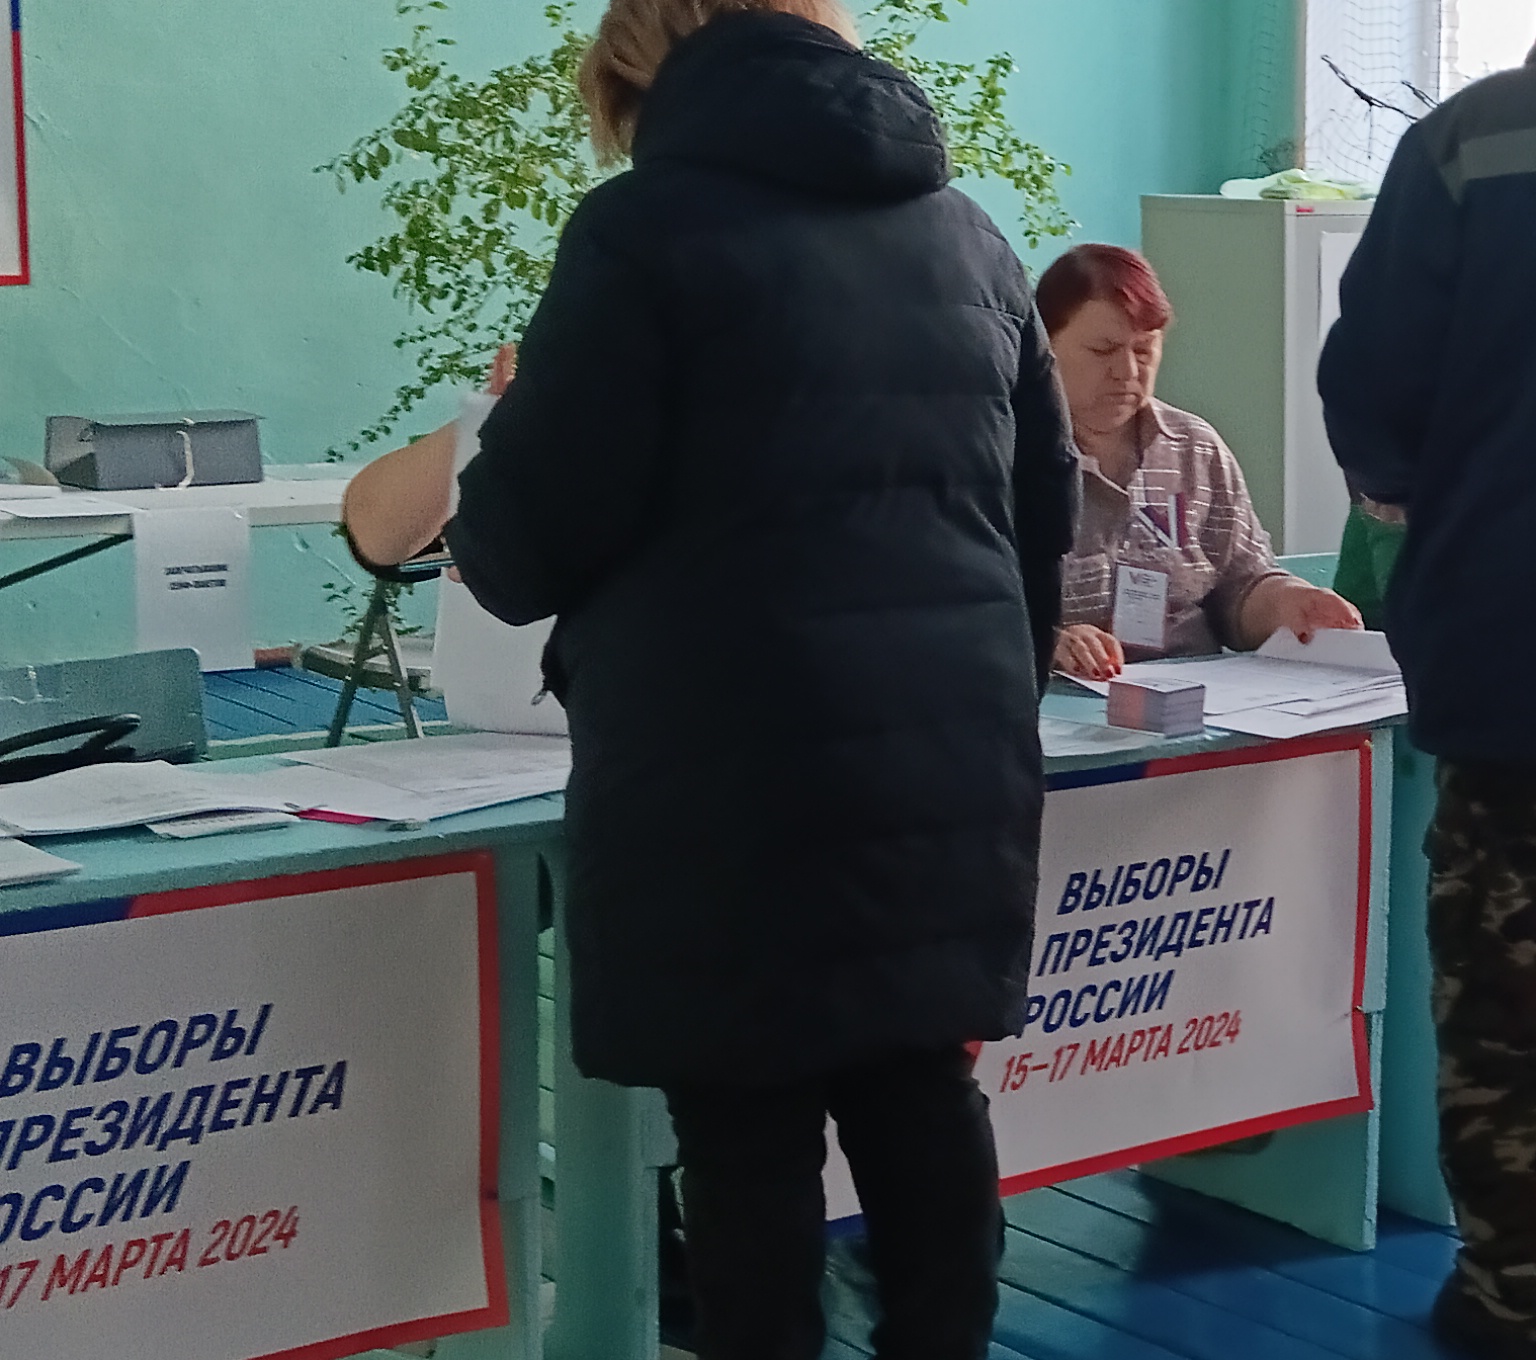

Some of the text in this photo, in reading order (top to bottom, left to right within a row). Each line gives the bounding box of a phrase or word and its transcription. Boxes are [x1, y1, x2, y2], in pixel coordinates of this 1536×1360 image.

[1056, 848, 1232, 916] ВЫБОРЫ
[1034, 896, 1275, 977] ПРЕЗИДЕНТА
[1025, 969, 1175, 1033] РОССИИ
[0, 1003, 274, 1098] ВЫБОРЫ
[1080, 1023, 1174, 1076] МАРТА
[1176, 1009, 1241, 1055] 2024
[0, 1160, 191, 1242] ОССИИ
[0, 1205, 299, 1309] 17 МАРТА 2024
